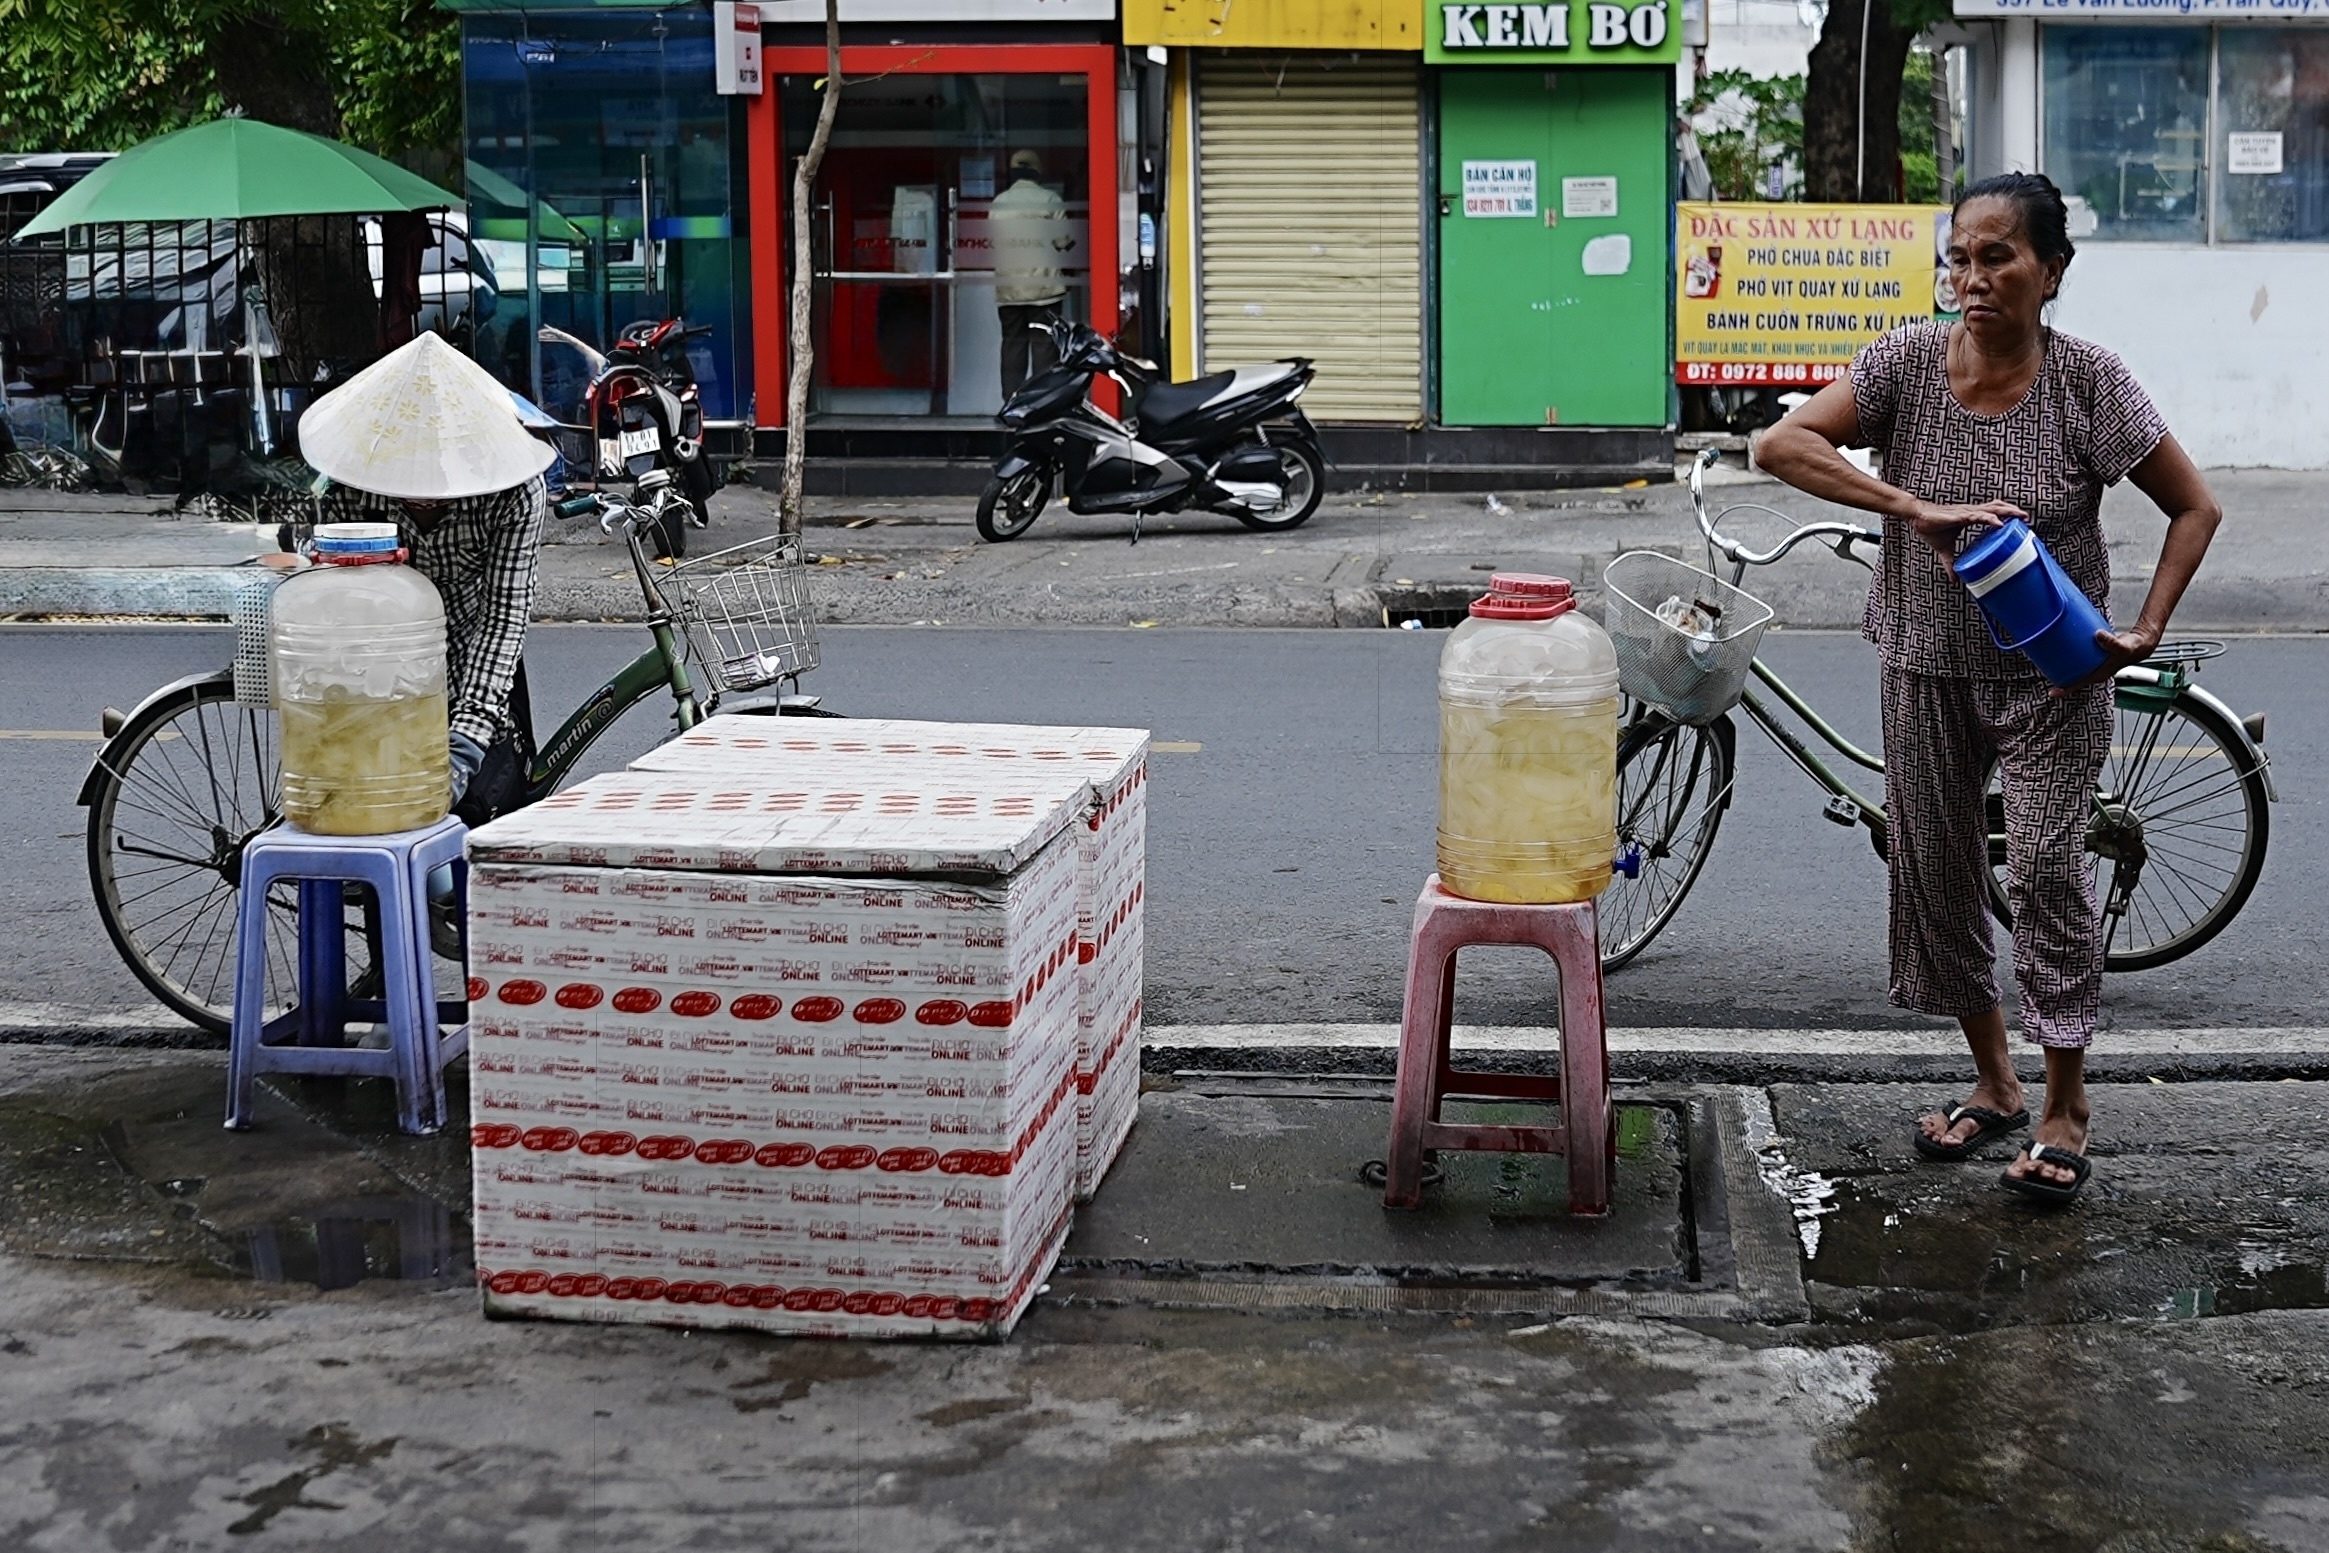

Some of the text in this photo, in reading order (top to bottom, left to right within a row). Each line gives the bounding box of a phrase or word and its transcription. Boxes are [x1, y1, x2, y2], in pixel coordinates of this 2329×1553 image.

[1443, 1, 1668, 47] KEM BƠ
[1852, 219, 1915, 246] LẠNG
[1782, 249, 1820, 266] CHUA
[1860, 247, 1890, 271] BIỆT
[1772, 280, 1794, 302] VỊT
[1800, 281, 1836, 299] QUAY
[1865, 281, 1901, 302] LẠNG
[1721, 364, 1768, 381] 0972
[546, 718, 592, 768] martin
[563, 884, 599, 895] ONLINE
[709, 893, 748, 903] ONLINE
[863, 898, 903, 908] ONLINE
[513, 917, 549, 928] ONLINE
[657, 926, 695, 937] ONLINE
[809, 933, 849, 944] ONLINE
[965, 937, 1005, 948] ONLINE
[631, 963, 669, 974] ONLINE
[781, 971, 821, 981] ONLINE
[936, 975, 976, 985] ONLINE
[776, 1046, 815, 1056] ONLINE
[931, 1050, 971, 1060] ONLINE
[771, 1083, 810, 1094] ONLINE
[926, 1087, 966, 1098] ONLINE
[776, 1119, 815, 1130] ONLINE
[930, 1124, 969, 1134] ONLINE
